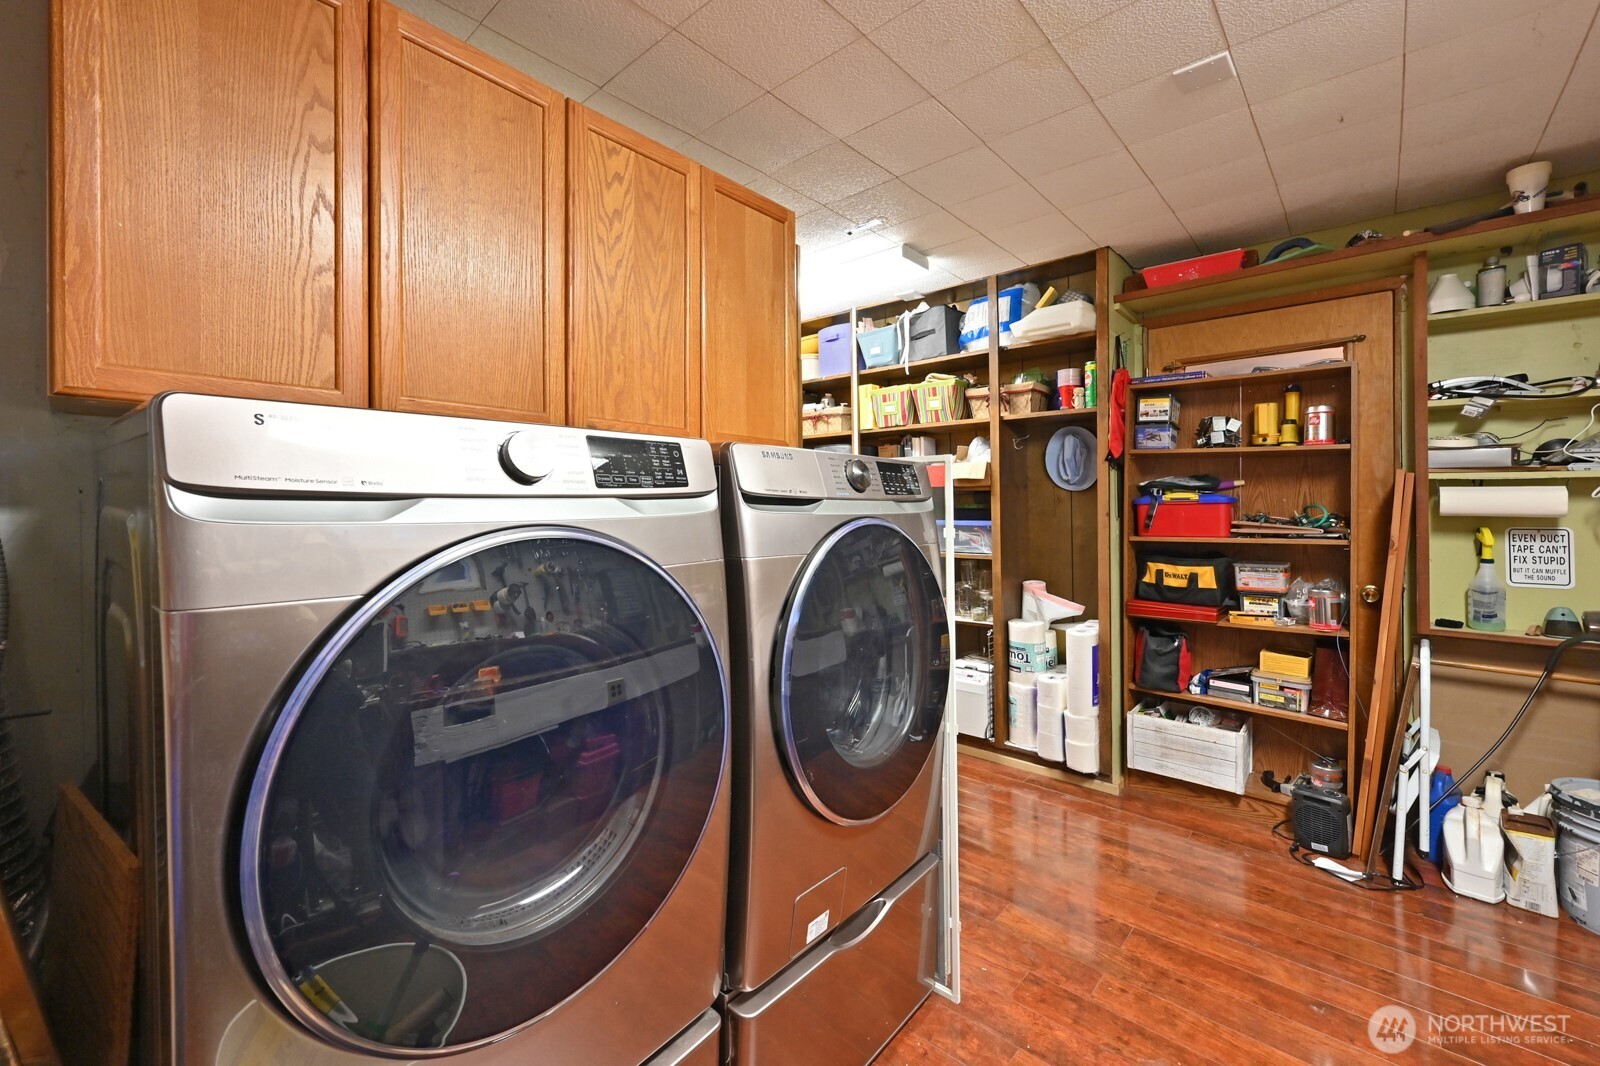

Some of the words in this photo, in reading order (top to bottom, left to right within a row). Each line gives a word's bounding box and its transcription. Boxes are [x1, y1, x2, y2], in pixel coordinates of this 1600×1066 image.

[761, 450, 794, 460] SAMSUNG
[1512, 533, 1536, 543] EVEN
[1540, 534, 1566, 543] DUCT
[1511, 544, 1535, 553] TAPE
[1538, 545, 1568, 555] CAN'T
[1513, 555, 1528, 564] FIX
[1531, 556, 1566, 566] STUPID
